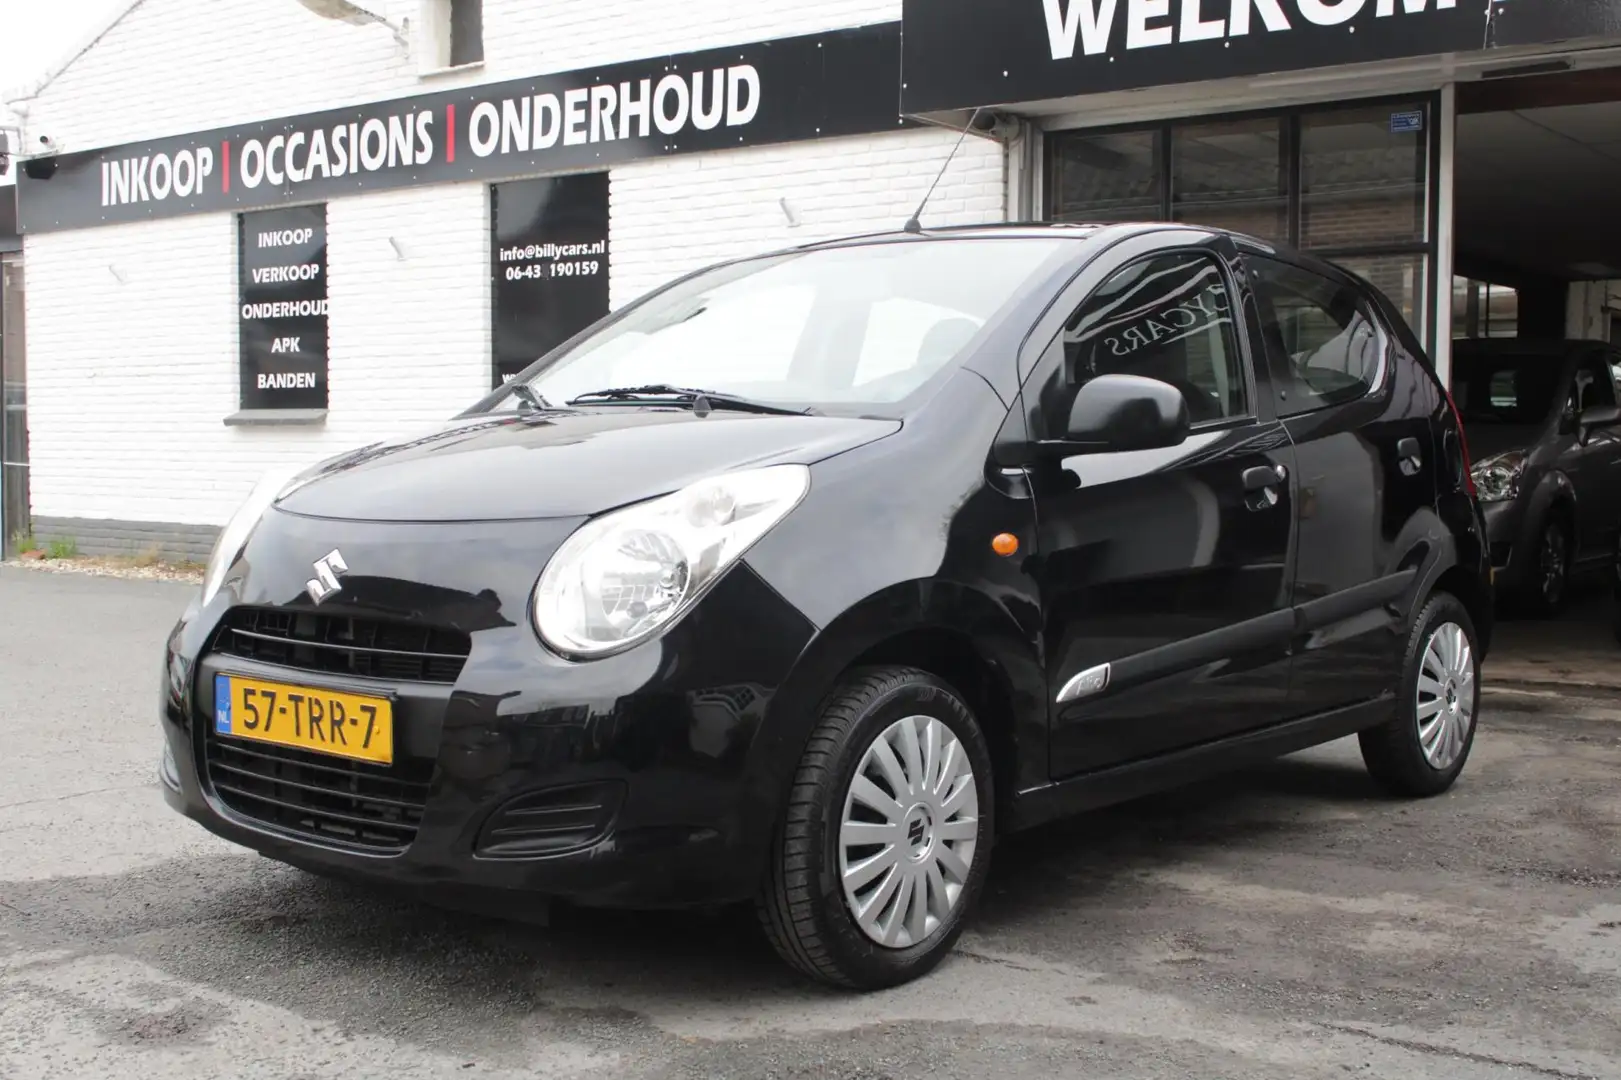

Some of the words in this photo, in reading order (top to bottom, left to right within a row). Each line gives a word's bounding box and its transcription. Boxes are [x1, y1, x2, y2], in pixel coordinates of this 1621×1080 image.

[1041, 0, 1456, 60] WEL
[102, 146, 213, 206] INKOOP
[240, 110, 433, 188] OCCASIONS
[469, 65, 760, 157] ONDERHOUD
[258, 228, 313, 247] INKOOP
[500, 240, 605, 260] info@billycars.nl
[252, 264, 319, 283] VERKOOP
[506, 265, 541, 280] 06-43
[550, 261, 598, 276] 190159
[242, 300, 328, 319] ONDERHOUD
[271, 337, 300, 353] APK
[257, 373, 316, 389] BANDEN
[217, 709, 230, 724] NL
[243, 687, 377, 749] 57-TRR-7
